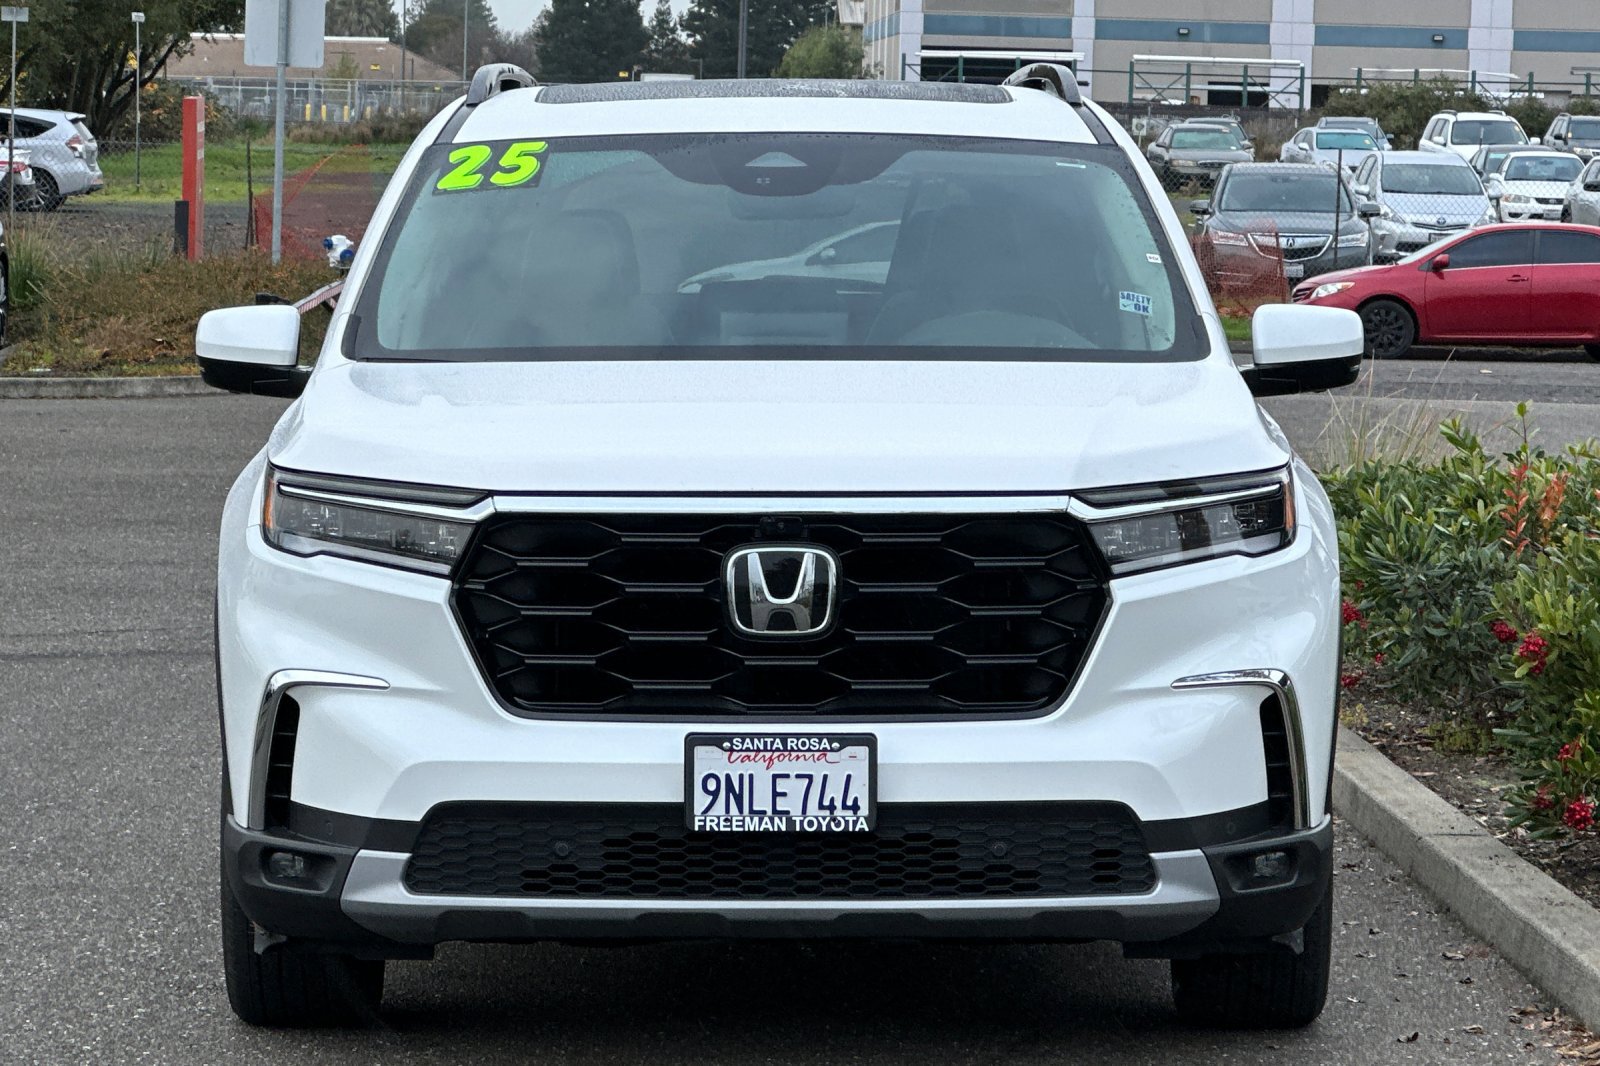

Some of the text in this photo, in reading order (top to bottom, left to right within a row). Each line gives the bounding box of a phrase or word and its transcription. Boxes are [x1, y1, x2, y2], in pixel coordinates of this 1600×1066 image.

[437, 141, 548, 190] 25
[1120, 292, 1151, 305] SAFETY
[1134, 303, 1150, 314] OK
[732, 737, 831, 750] SANTA ROSA
[727, 751, 840, 770] California
[700, 773, 861, 815] 9NLE744
[694, 816, 869, 832] FREEMAN TOYOTA
